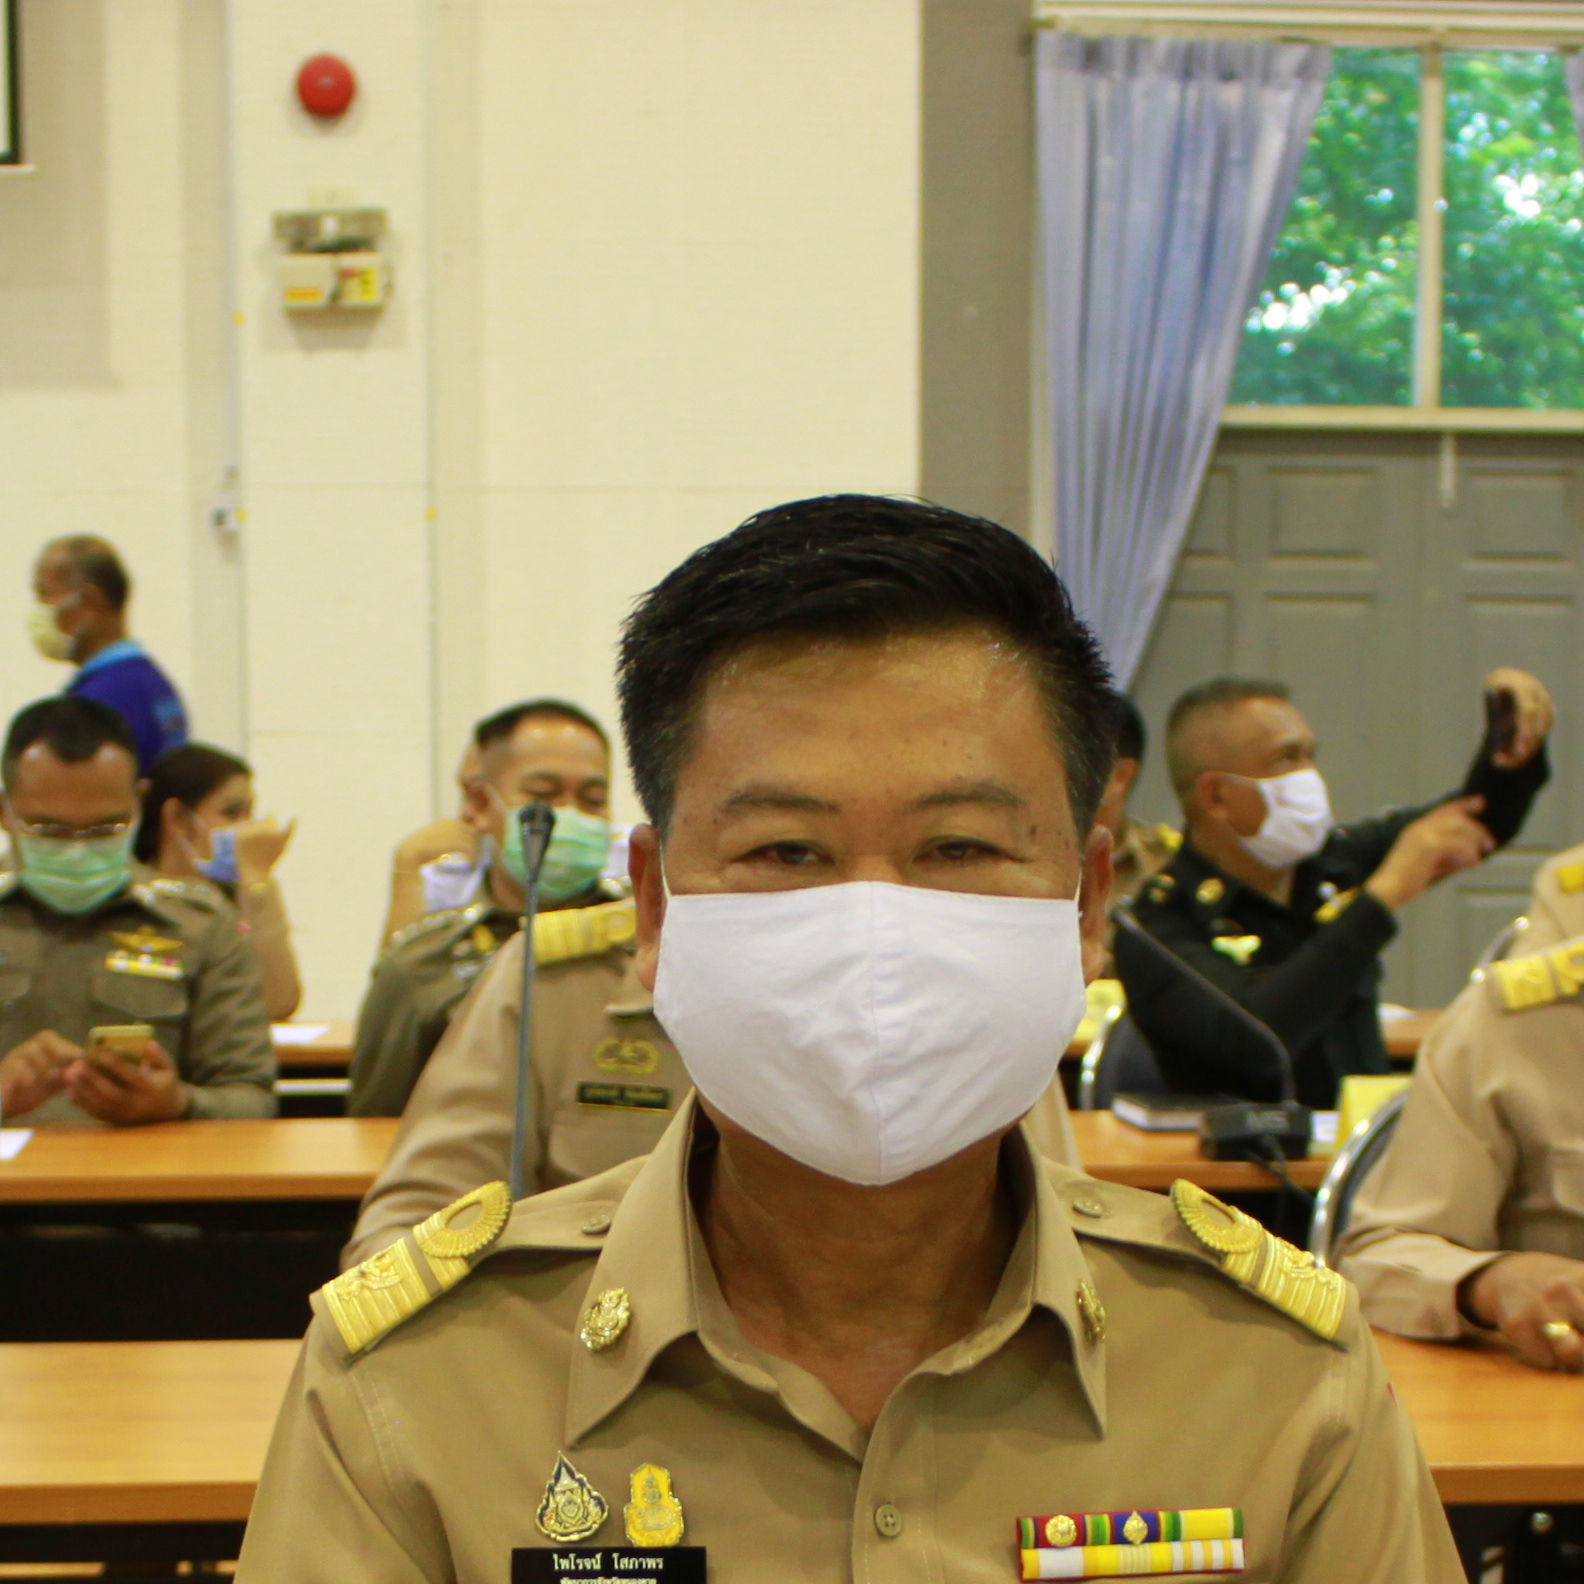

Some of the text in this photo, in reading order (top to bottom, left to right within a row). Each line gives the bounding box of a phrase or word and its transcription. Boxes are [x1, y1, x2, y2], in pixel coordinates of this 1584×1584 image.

[552, 1552, 664, 1571] ไพโรจน์ โสภาพร
